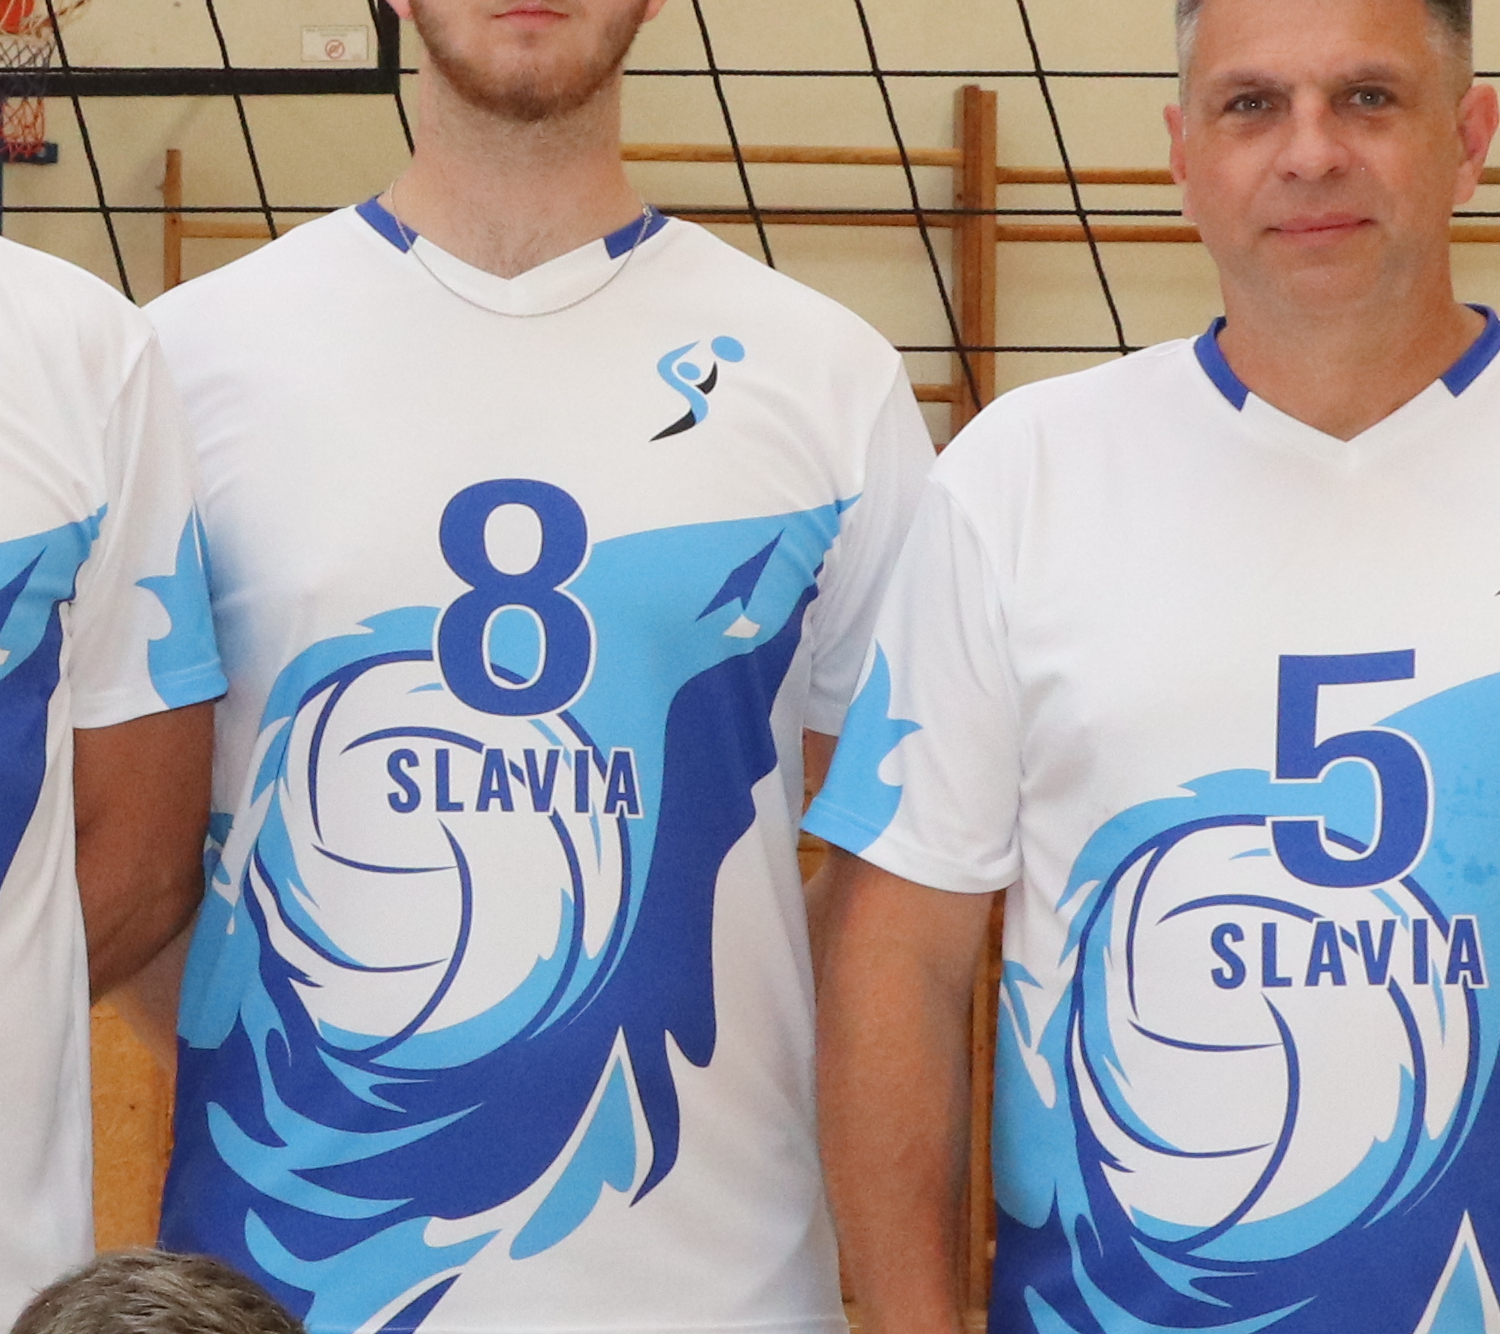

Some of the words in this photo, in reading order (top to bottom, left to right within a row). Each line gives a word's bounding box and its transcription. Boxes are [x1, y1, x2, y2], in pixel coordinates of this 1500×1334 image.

[437, 478, 593, 716] 8
[387, 749, 641, 818] SLAVIA
[1271, 649, 1430, 888] 5
[1210, 916, 1486, 988] SLAVIA
